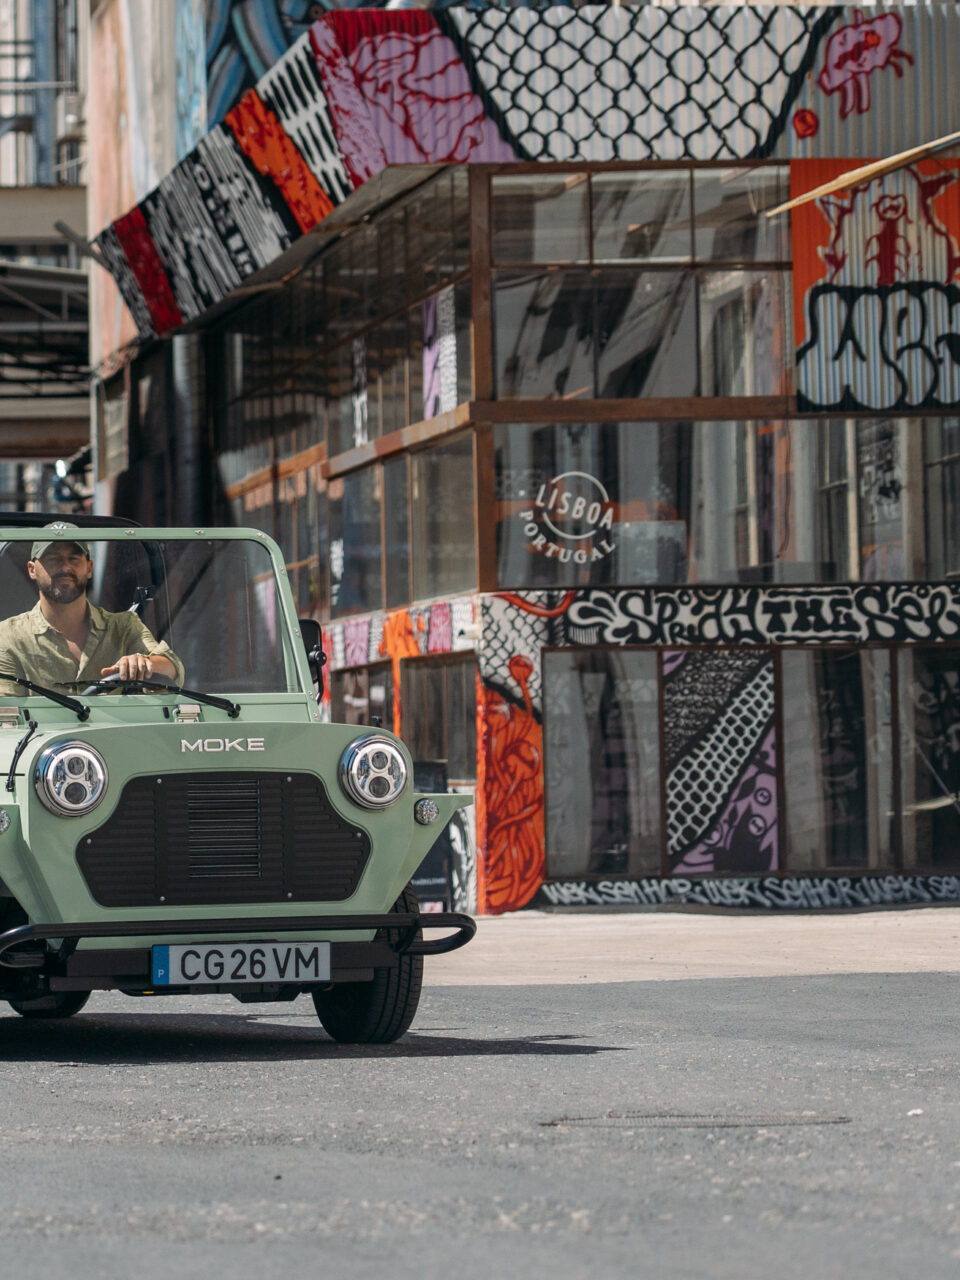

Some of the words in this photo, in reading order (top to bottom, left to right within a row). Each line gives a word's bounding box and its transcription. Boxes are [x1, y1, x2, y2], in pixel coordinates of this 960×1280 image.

[535, 483, 615, 531] LISBOA
[520, 509, 617, 564] PORTUGAL
[180, 737, 265, 753] MOKE
[156, 969, 166, 979] P
